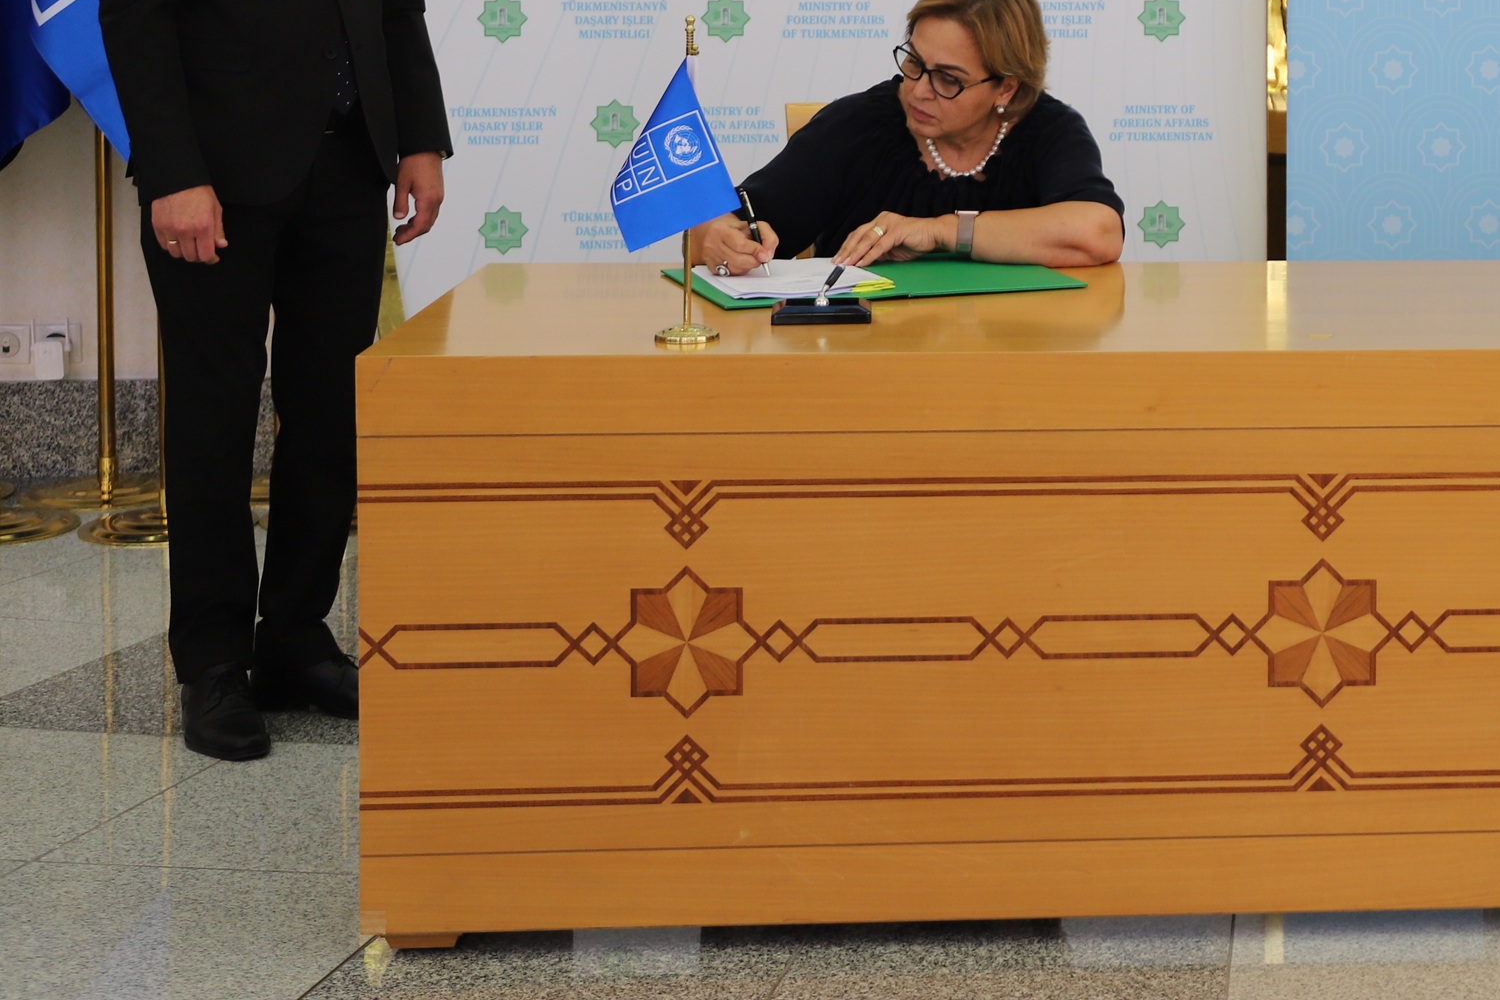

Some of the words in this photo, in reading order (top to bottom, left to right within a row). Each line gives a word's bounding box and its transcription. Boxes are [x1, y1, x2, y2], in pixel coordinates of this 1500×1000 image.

[799, 1, 852, 11] MINISTRY
[856, 2, 870, 11] OF
[575, 16, 617, 26] DAŞARY
[623, 15, 654, 26] IŞLER
[786, 15, 835, 25] FOREIGN
[840, 15, 885, 25] AFFAIRS
[1061, 15, 1092, 26] IŞLER
[579, 29, 651, 39] MINISTRLIGI
[782, 29, 797, 38] OF
[800, 28, 889, 39] TURKMENISTAN
[1046, 28, 1089, 38] STRLIGI
[703, 106, 743, 116] NISTRY
[745, 106, 761, 116] OF
[1124, 105, 1178, 114] MINISTRY
[1180, 105, 1195, 114] OF
[463, 121, 506, 132] DAŞARY
[512, 121, 543, 132] IŞLER
[729, 120, 776, 129] AFFAIRS
[1113, 118, 1161, 128] FOREIGN
[1166, 118, 1209, 128] AFFAIRS
[467, 136, 540, 146] MINISTRLIGI
[1110, 132, 1124, 141] OF
[1127, 132, 1214, 141] TURKMENISTAN
